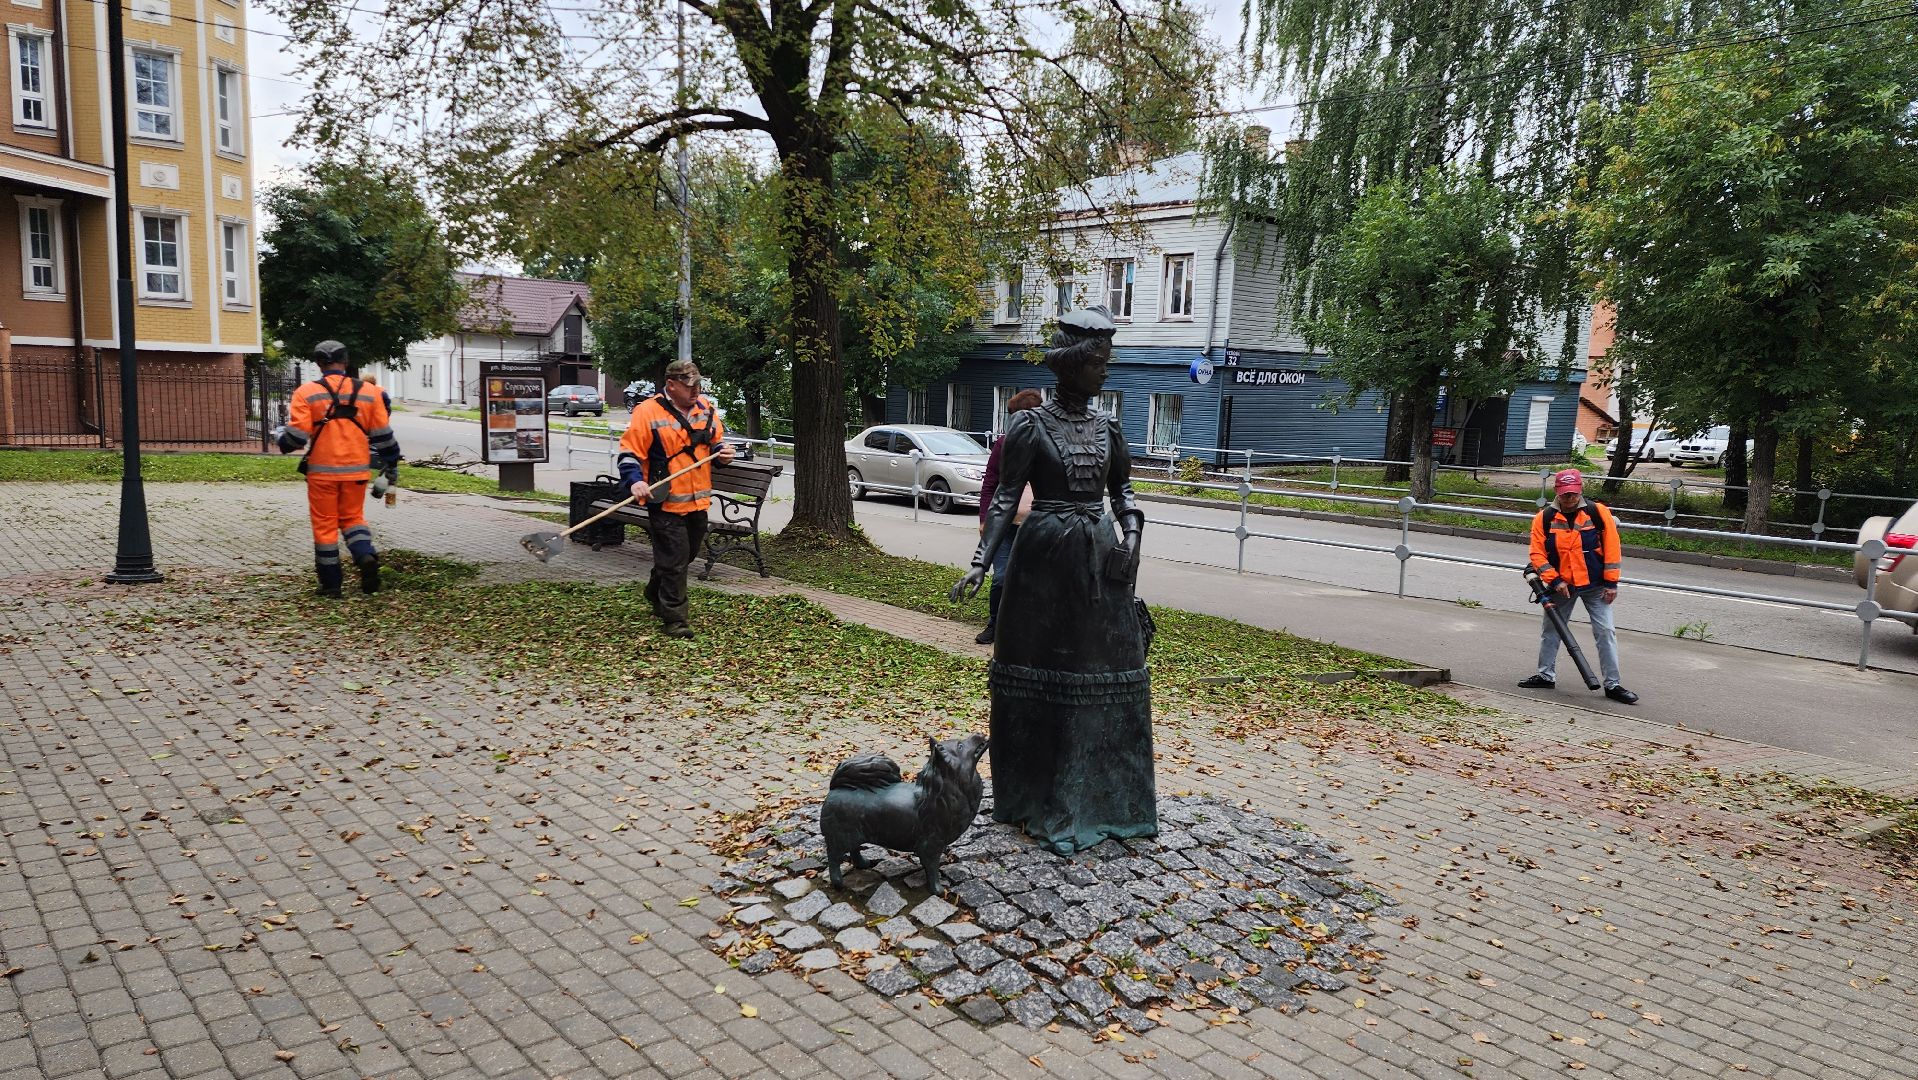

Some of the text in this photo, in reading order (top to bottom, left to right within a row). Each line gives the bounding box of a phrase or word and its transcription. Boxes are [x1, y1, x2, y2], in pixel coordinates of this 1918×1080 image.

[1227, 356, 1237, 366] 32
[1236, 369, 1305, 385] ВСЁ ДЛЯ ОКОН
[505, 382, 540, 394] Серпухов
